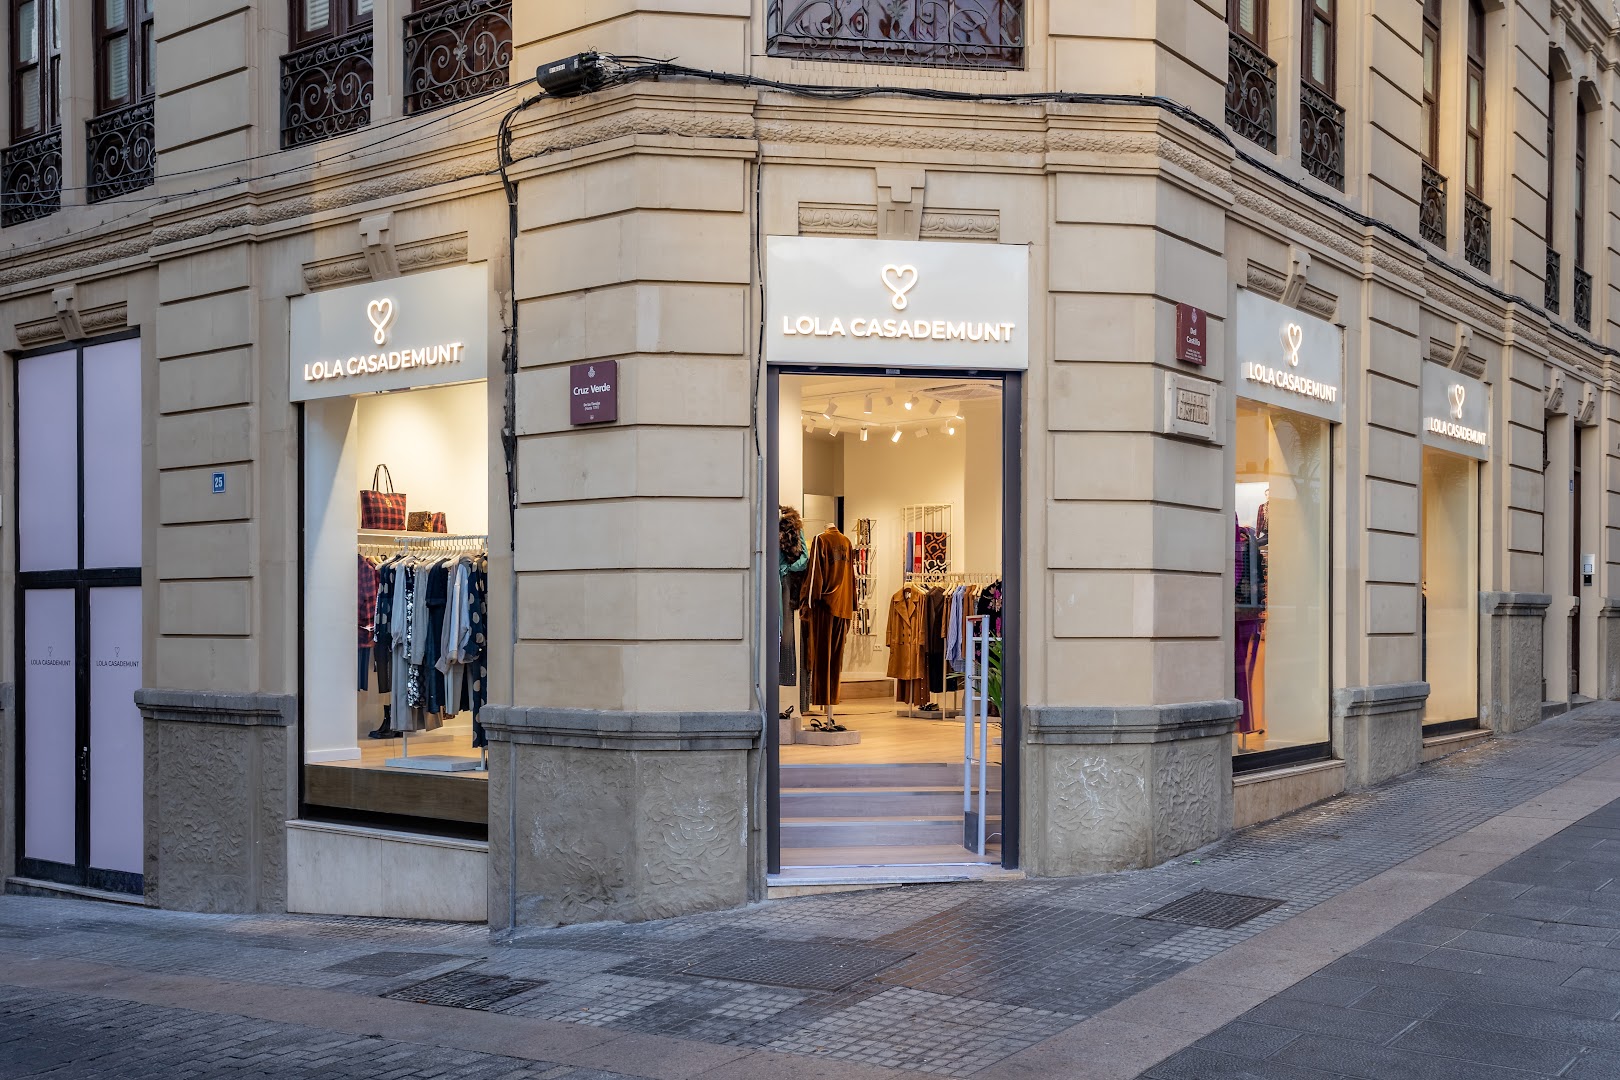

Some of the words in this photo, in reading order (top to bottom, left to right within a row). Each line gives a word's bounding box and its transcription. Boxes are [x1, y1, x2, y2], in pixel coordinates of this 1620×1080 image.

[783, 315, 846, 336] LOLA
[850, 318, 1015, 342] CASADEMUNT
[304, 359, 344, 381] LOLA
[346, 342, 463, 375] CASADEMUNT
[573, 386, 590, 396] Cruz
[590, 382, 611, 394] Verde
[1249, 361, 1276, 386] LOLA
[1276, 370, 1337, 403] CASADEMUNT
[1430, 416, 1448, 435] LOLA
[1447, 422, 1486, 446] CASADEMUNT
[214, 476, 223, 488] 25
[42, 659, 71, 667] CASADEMUNT
[108, 660, 140, 668] CASADEMUNT
